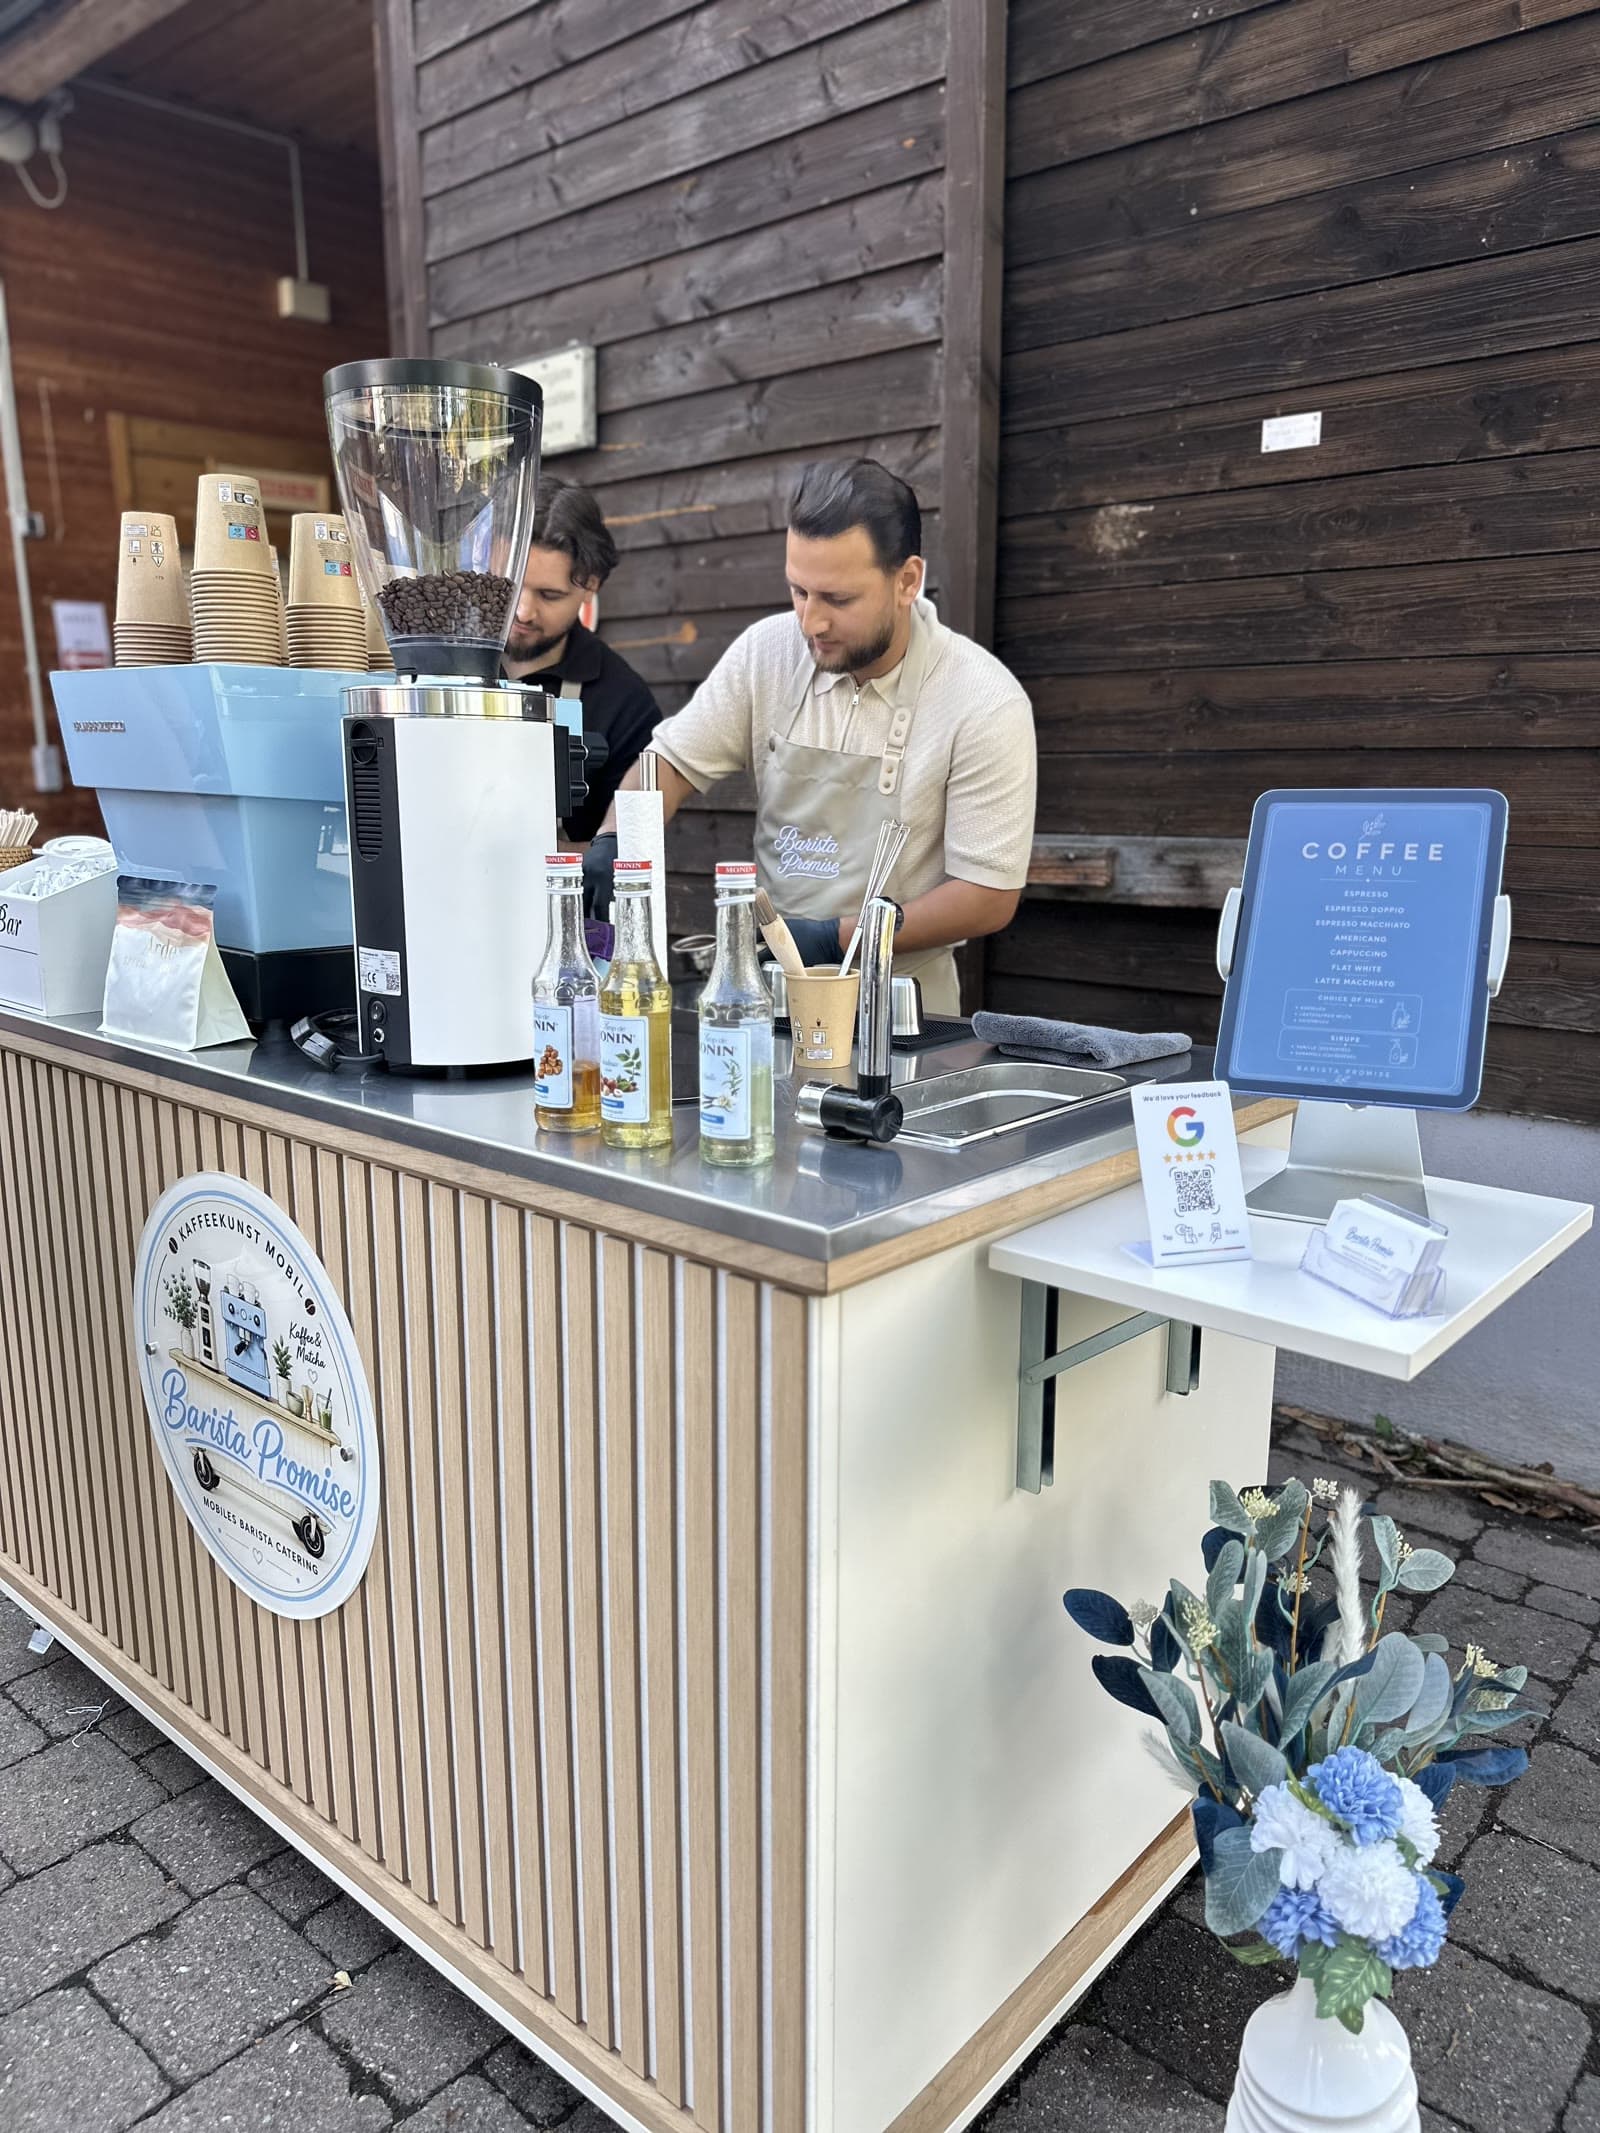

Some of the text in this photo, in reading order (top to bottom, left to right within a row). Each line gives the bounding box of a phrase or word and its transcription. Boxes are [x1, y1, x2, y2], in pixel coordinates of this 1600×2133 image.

[774, 825, 839, 854] Barista
[1302, 842, 1444, 861] COFFEE
[777, 851, 840, 879] Promise
[1335, 865, 1402, 876] MENU
[1344, 890, 1389, 899] ESPRESSO
[1325, 905, 1405, 915] ESPRESSO DOPPIO
[1315, 919, 1411, 930] ESPRESSO MACCHIATO
[1334, 934, 1387, 943] AMERICANO
[1330, 949, 1388, 958] CAPPUCCINO
[1331, 963, 1382, 973] FLAT WHITE
[1315, 977, 1396, 988] LATTE MACCHIATO
[535, 1020, 556, 1032] NIN
[601, 1031, 633, 1044] ONIN
[702, 1043, 735, 1057] ONIN
[178, 1212, 304, 1298] KAFFEEKUNST MOBIL
[296, 1346, 327, 1369] Matcha
[161, 1368, 356, 1519] Barista Promise
[203, 1495, 319, 1576] MOBILES BARISTA CATERING
